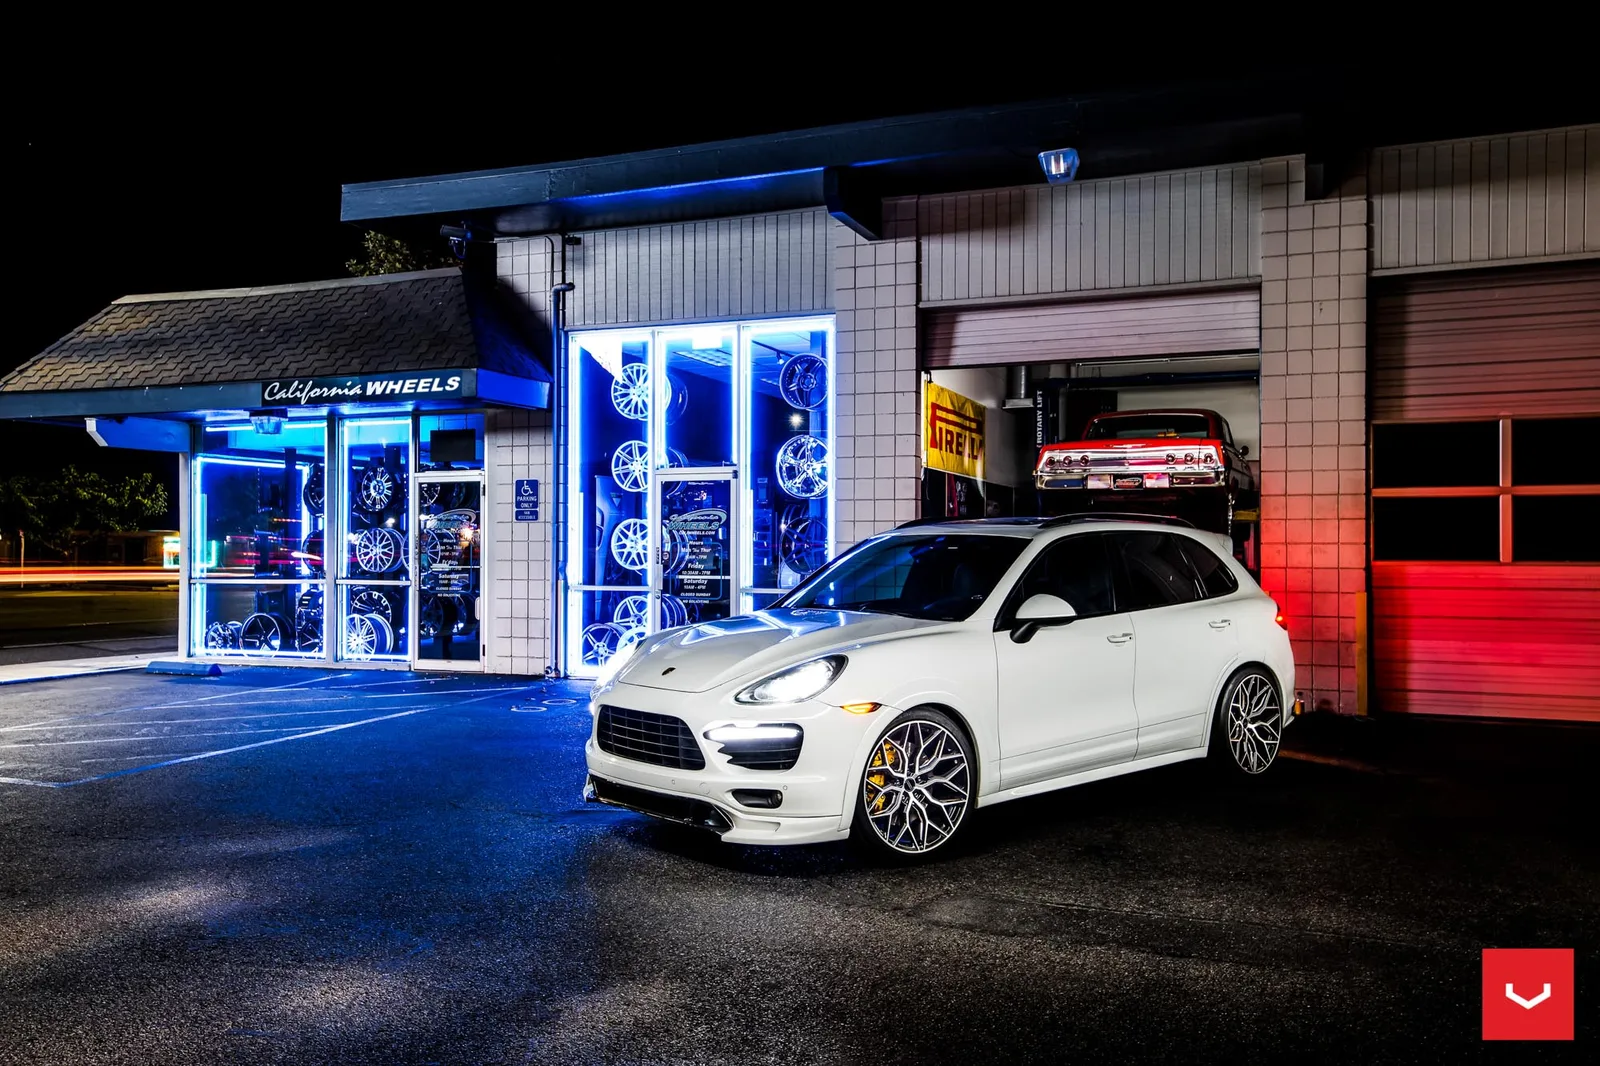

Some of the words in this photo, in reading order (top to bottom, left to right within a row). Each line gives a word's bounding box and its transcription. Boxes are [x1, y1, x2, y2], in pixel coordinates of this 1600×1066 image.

[264, 380, 363, 405] California
[365, 376, 461, 396] WHEELS
[667, 521, 720, 531] WHEELS
